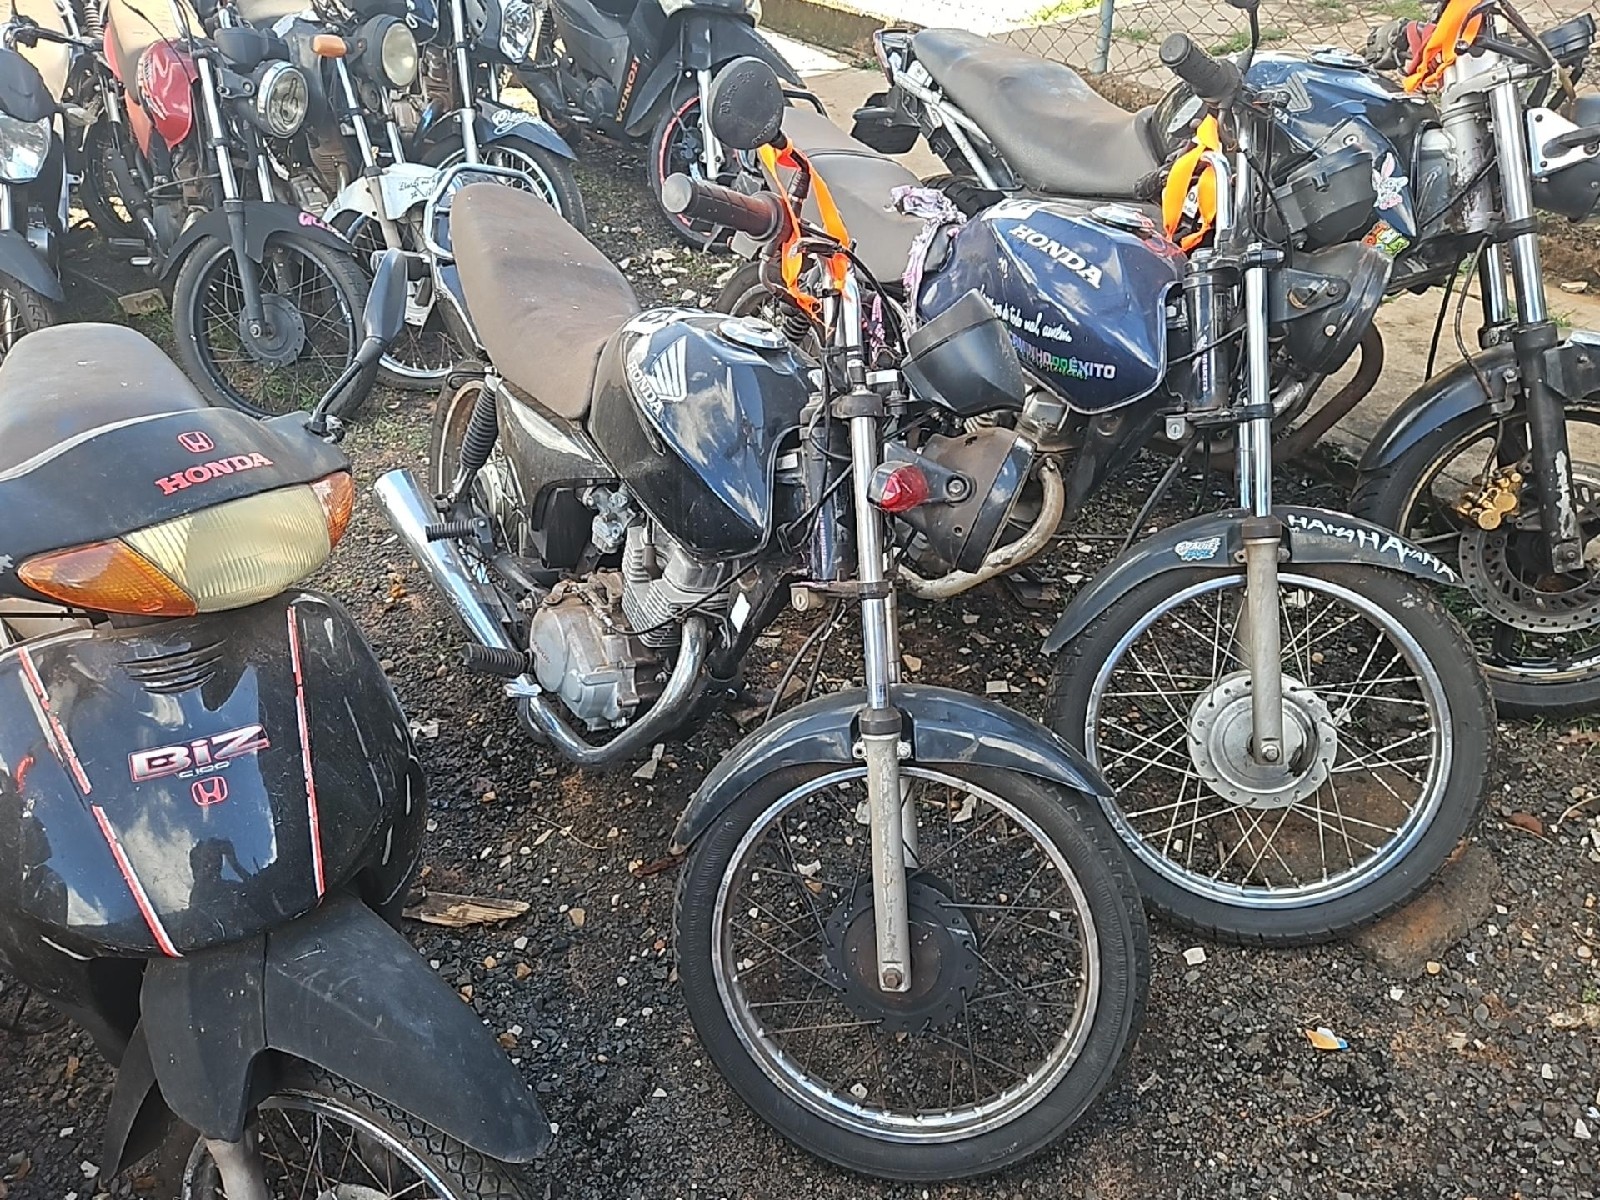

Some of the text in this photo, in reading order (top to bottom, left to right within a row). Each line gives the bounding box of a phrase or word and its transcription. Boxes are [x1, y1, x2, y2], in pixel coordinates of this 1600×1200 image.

[615, 54, 640, 123] HONDA
[1008, 223, 1102, 289] HONDA
[626, 359, 664, 418] HONDA
[155, 452, 274, 495] HONDA
